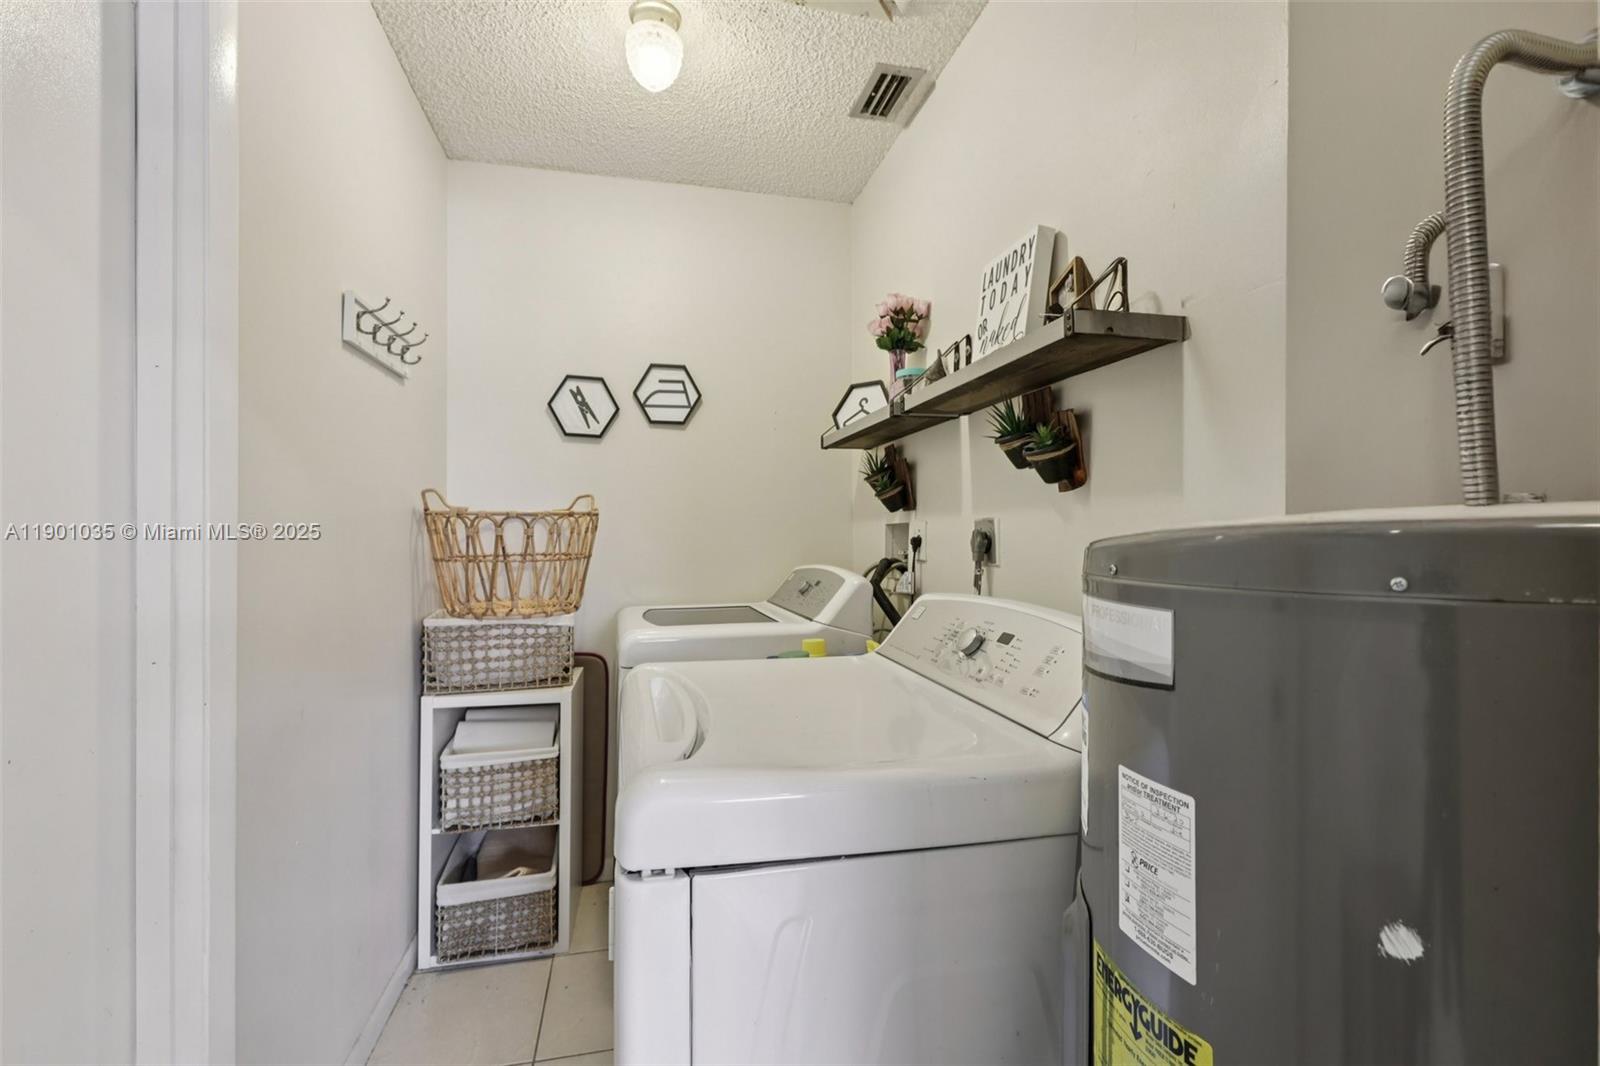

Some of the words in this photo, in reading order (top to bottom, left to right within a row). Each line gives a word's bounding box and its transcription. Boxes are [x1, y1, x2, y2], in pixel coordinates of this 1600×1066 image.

[982, 234, 1036, 293] LAUNDRY
[980, 262, 1032, 317] TODAY
[977, 317, 988, 341] OR
[1143, 791, 1181, 813] TREATMENT
[1149, 786, 1190, 809] INSPECTION
[1139, 858, 1159, 876] PRICE
